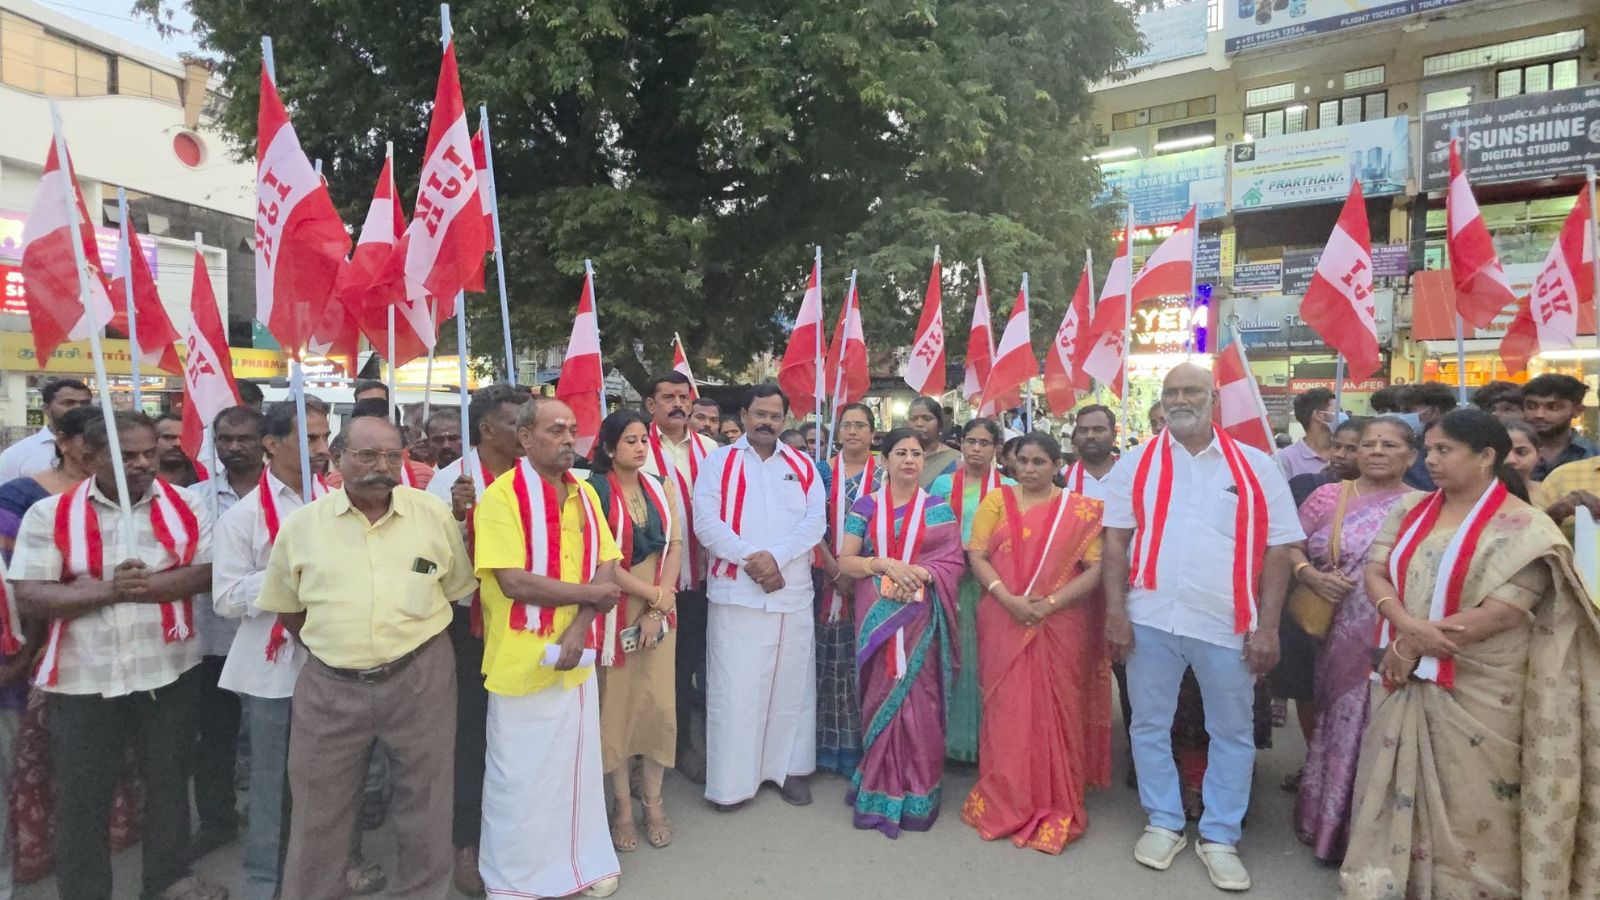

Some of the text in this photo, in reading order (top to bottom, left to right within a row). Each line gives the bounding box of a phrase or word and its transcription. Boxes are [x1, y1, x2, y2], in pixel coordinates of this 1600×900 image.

[1340, 14, 1371, 26] FLIGHT
[1372, 6, 1406, 23] TICKETS
[1469, 116, 1585, 150] SUNSHINE
[1481, 141, 1570, 162] DIGITAL STUDIO
[1268, 172, 1344, 191] PRARTHANA
[1283, 186, 1334, 197] TRADERS
[1224, 313, 1281, 333] Rainbow
[1292, 381, 1385, 391] MONEY TANSFER
